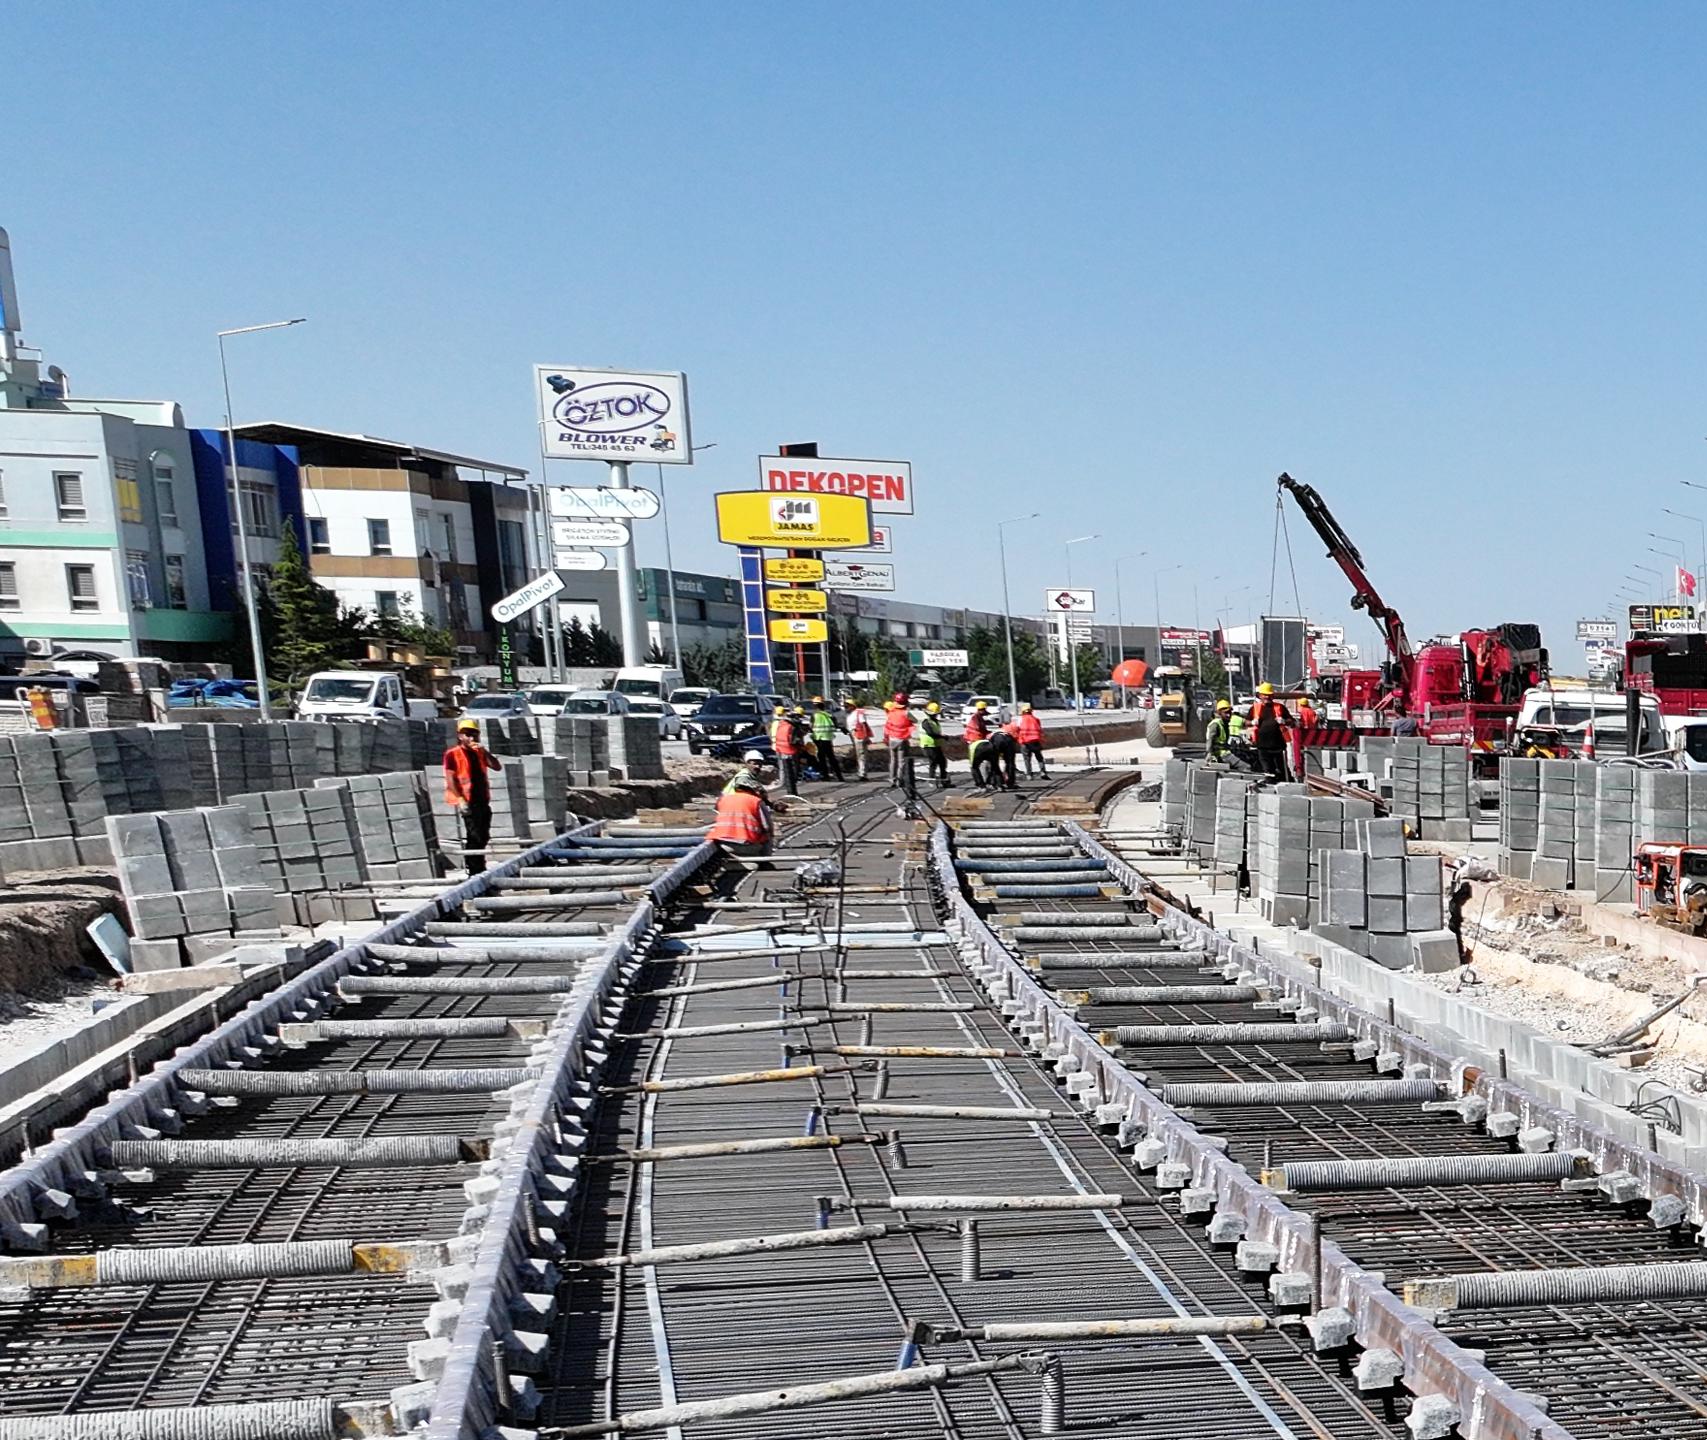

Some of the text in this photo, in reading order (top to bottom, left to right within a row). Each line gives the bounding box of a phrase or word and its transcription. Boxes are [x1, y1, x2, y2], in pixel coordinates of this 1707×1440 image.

[564, 391, 664, 425] ÖZTOK
[558, 433, 647, 445] BLOWER
[497, 578, 555, 617] OpalPivot
